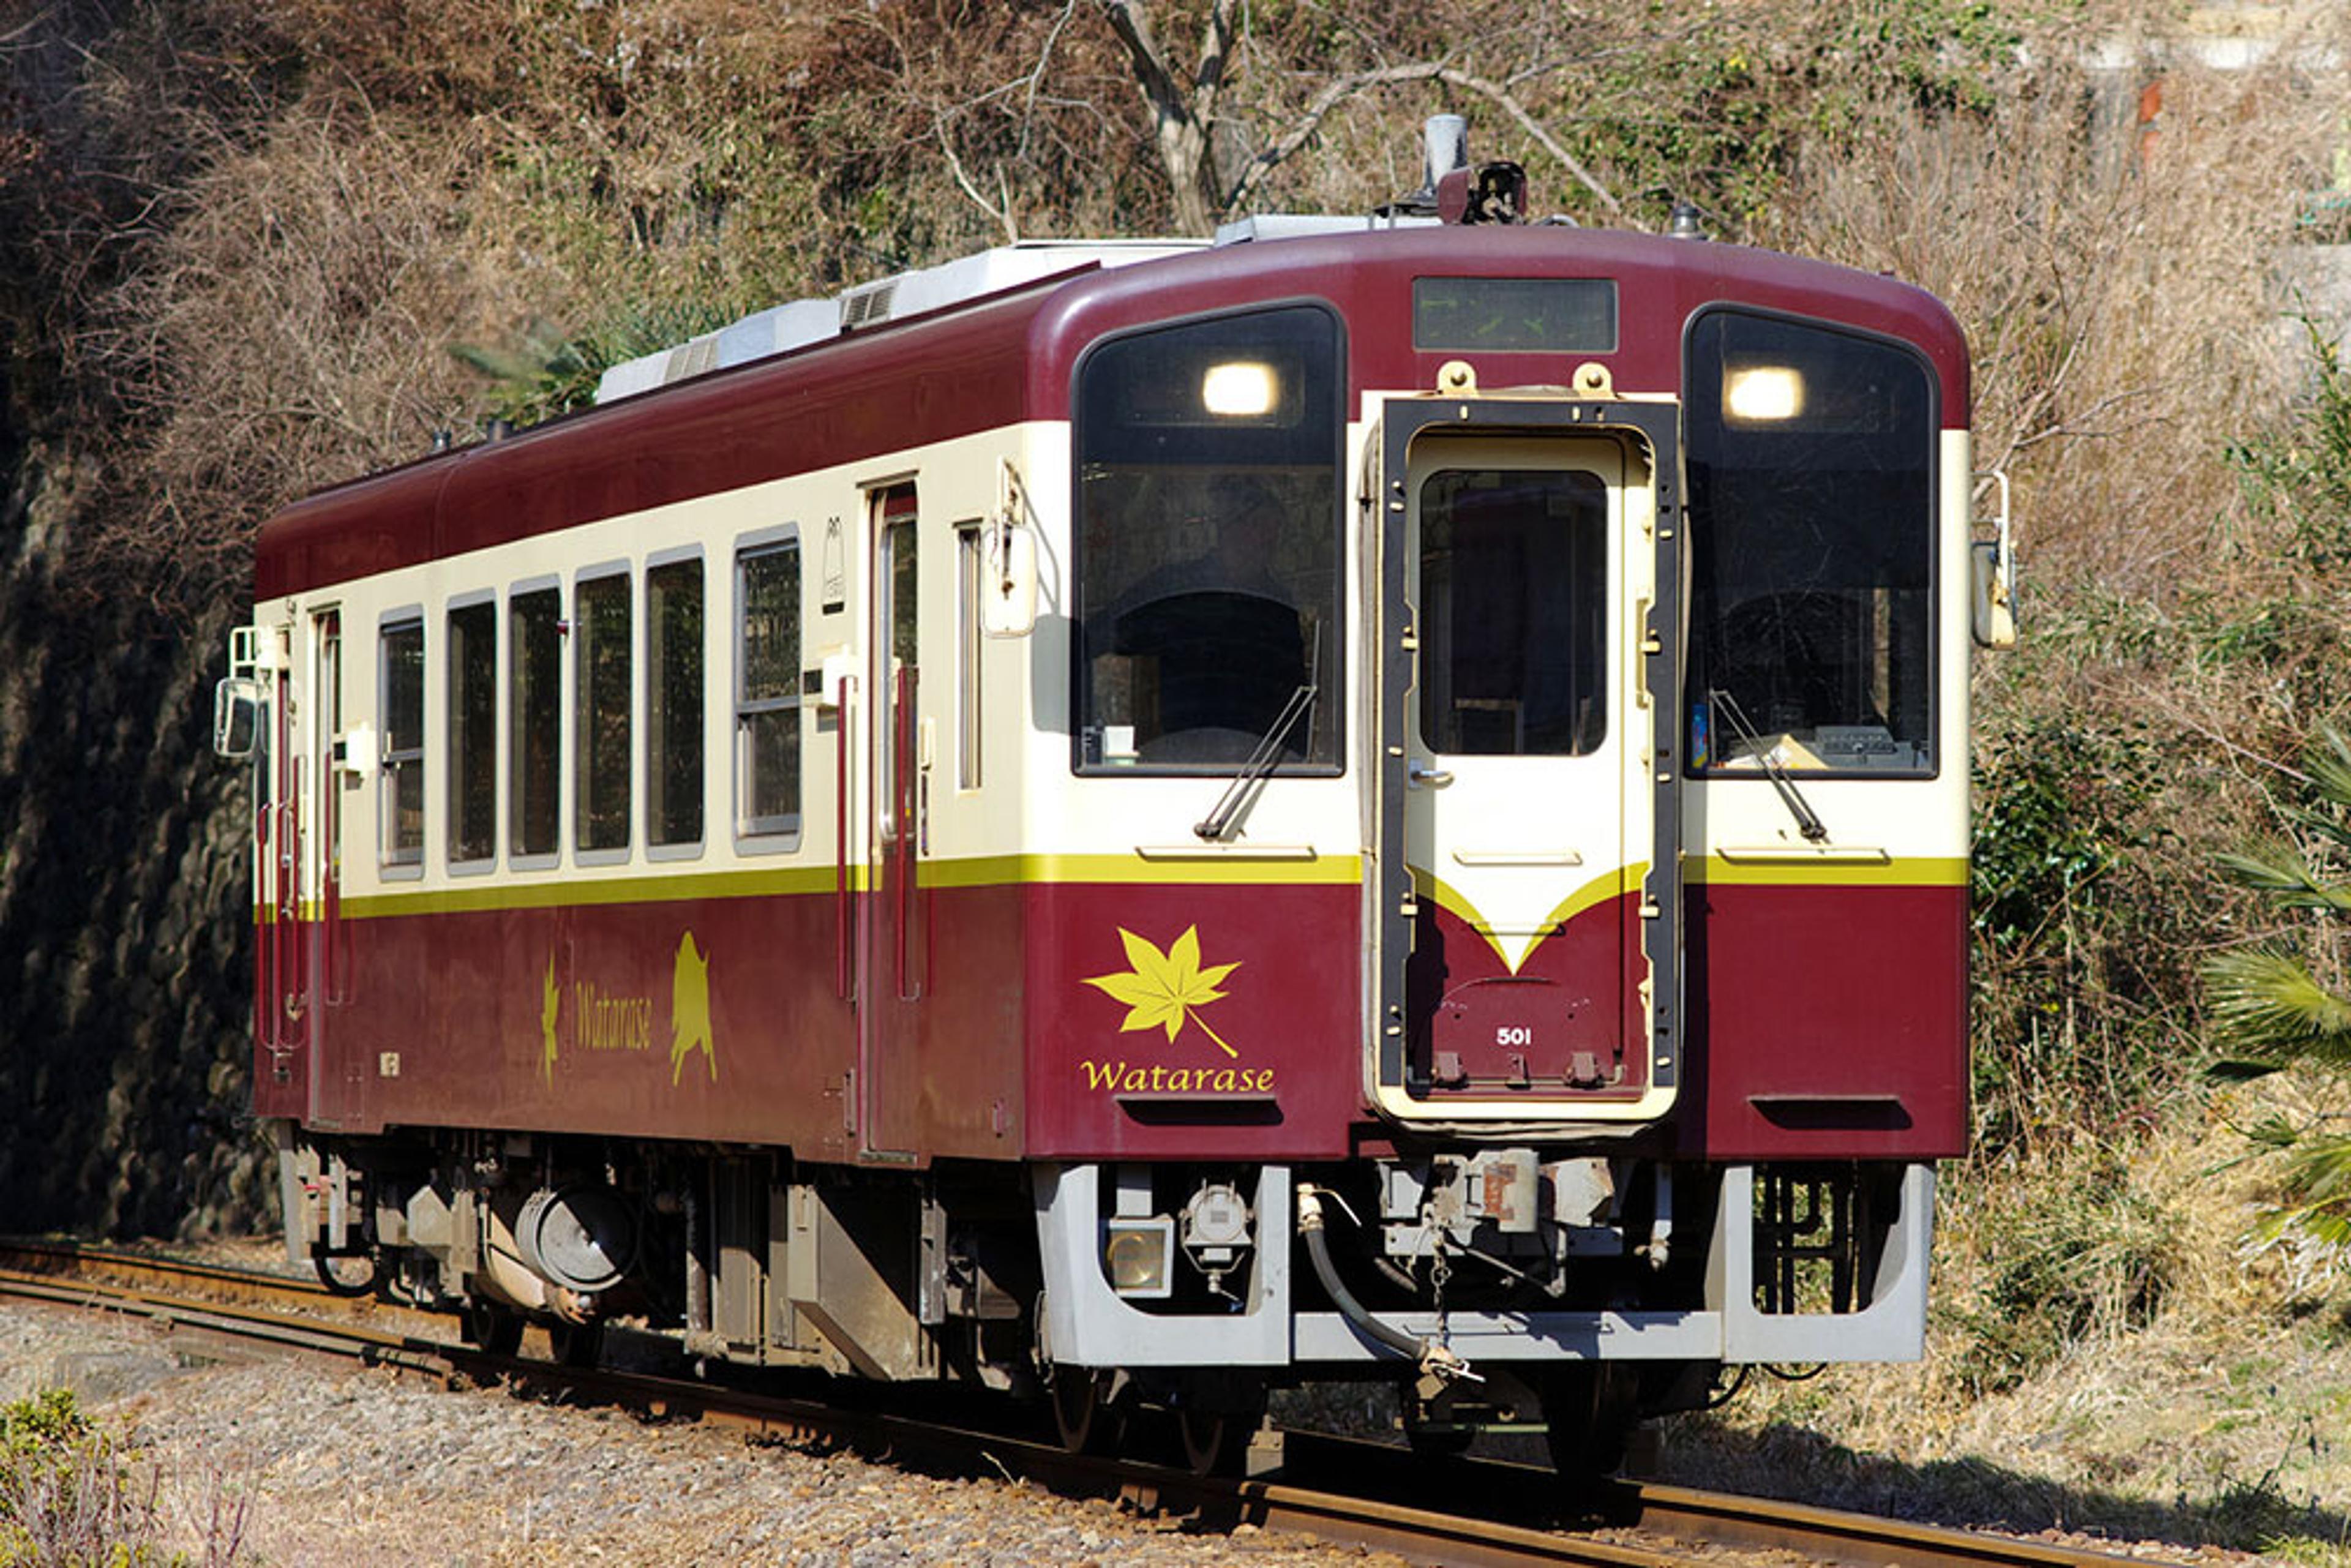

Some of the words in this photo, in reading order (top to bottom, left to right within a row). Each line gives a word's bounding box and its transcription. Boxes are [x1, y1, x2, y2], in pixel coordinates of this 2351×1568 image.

[576, 981, 651, 1049] Watarase
[1496, 1027, 1531, 1045] 501
[1081, 1060, 1274, 1092] Watarase
